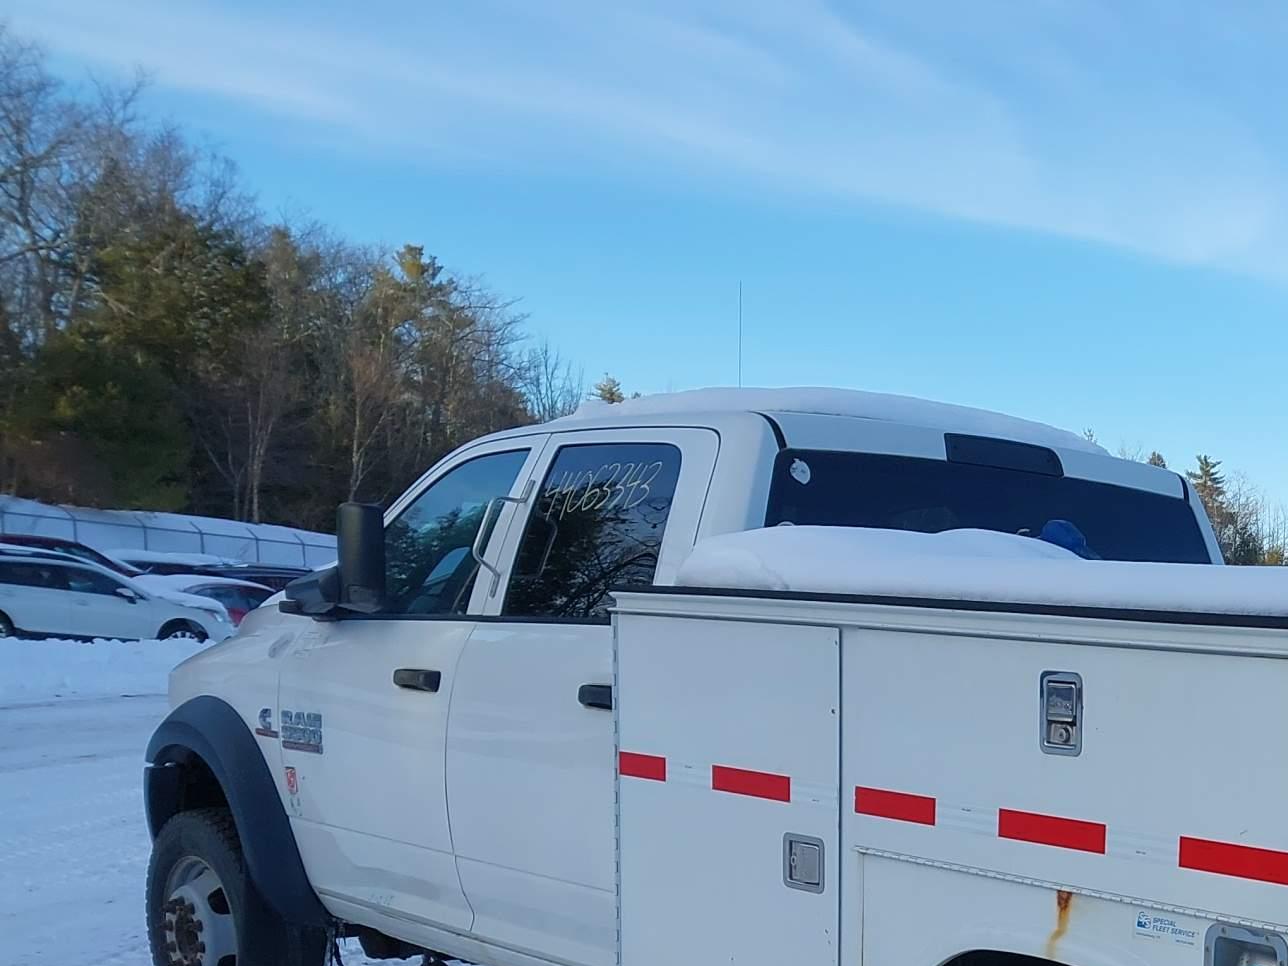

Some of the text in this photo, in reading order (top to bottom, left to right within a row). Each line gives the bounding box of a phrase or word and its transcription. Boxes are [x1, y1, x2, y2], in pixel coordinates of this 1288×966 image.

[545, 461, 663, 521] 44063343
[281, 710, 323, 729] RAM
[1152, 917, 1177, 927] SPECIAL
[1152, 924, 1170, 934] FLEET
[1170, 927, 1196, 938] SERVICE
